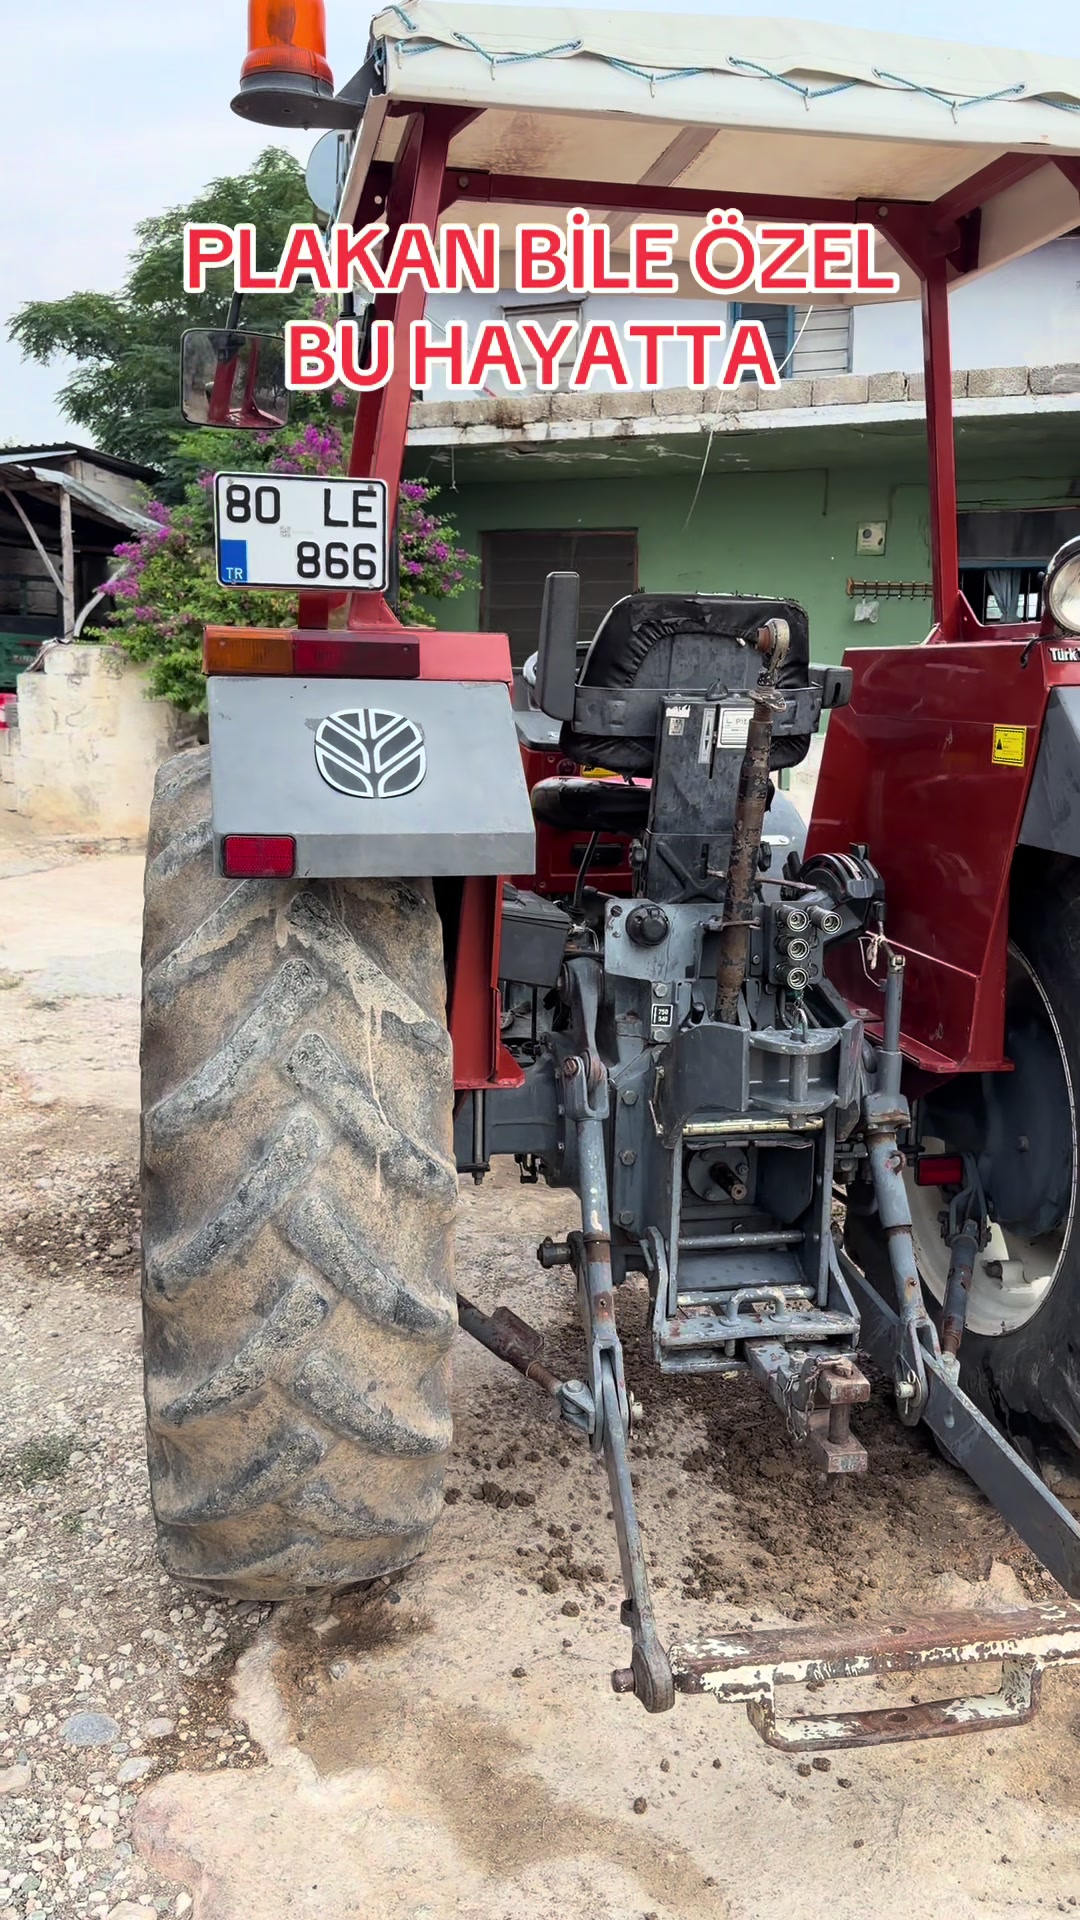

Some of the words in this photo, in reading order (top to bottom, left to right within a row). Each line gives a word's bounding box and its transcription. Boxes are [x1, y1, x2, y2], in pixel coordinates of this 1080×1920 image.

[225, 483, 281, 524] 80
[323, 487, 378, 529] LE
[225, 566, 244, 580] TR
[296, 540, 378, 581] 866
